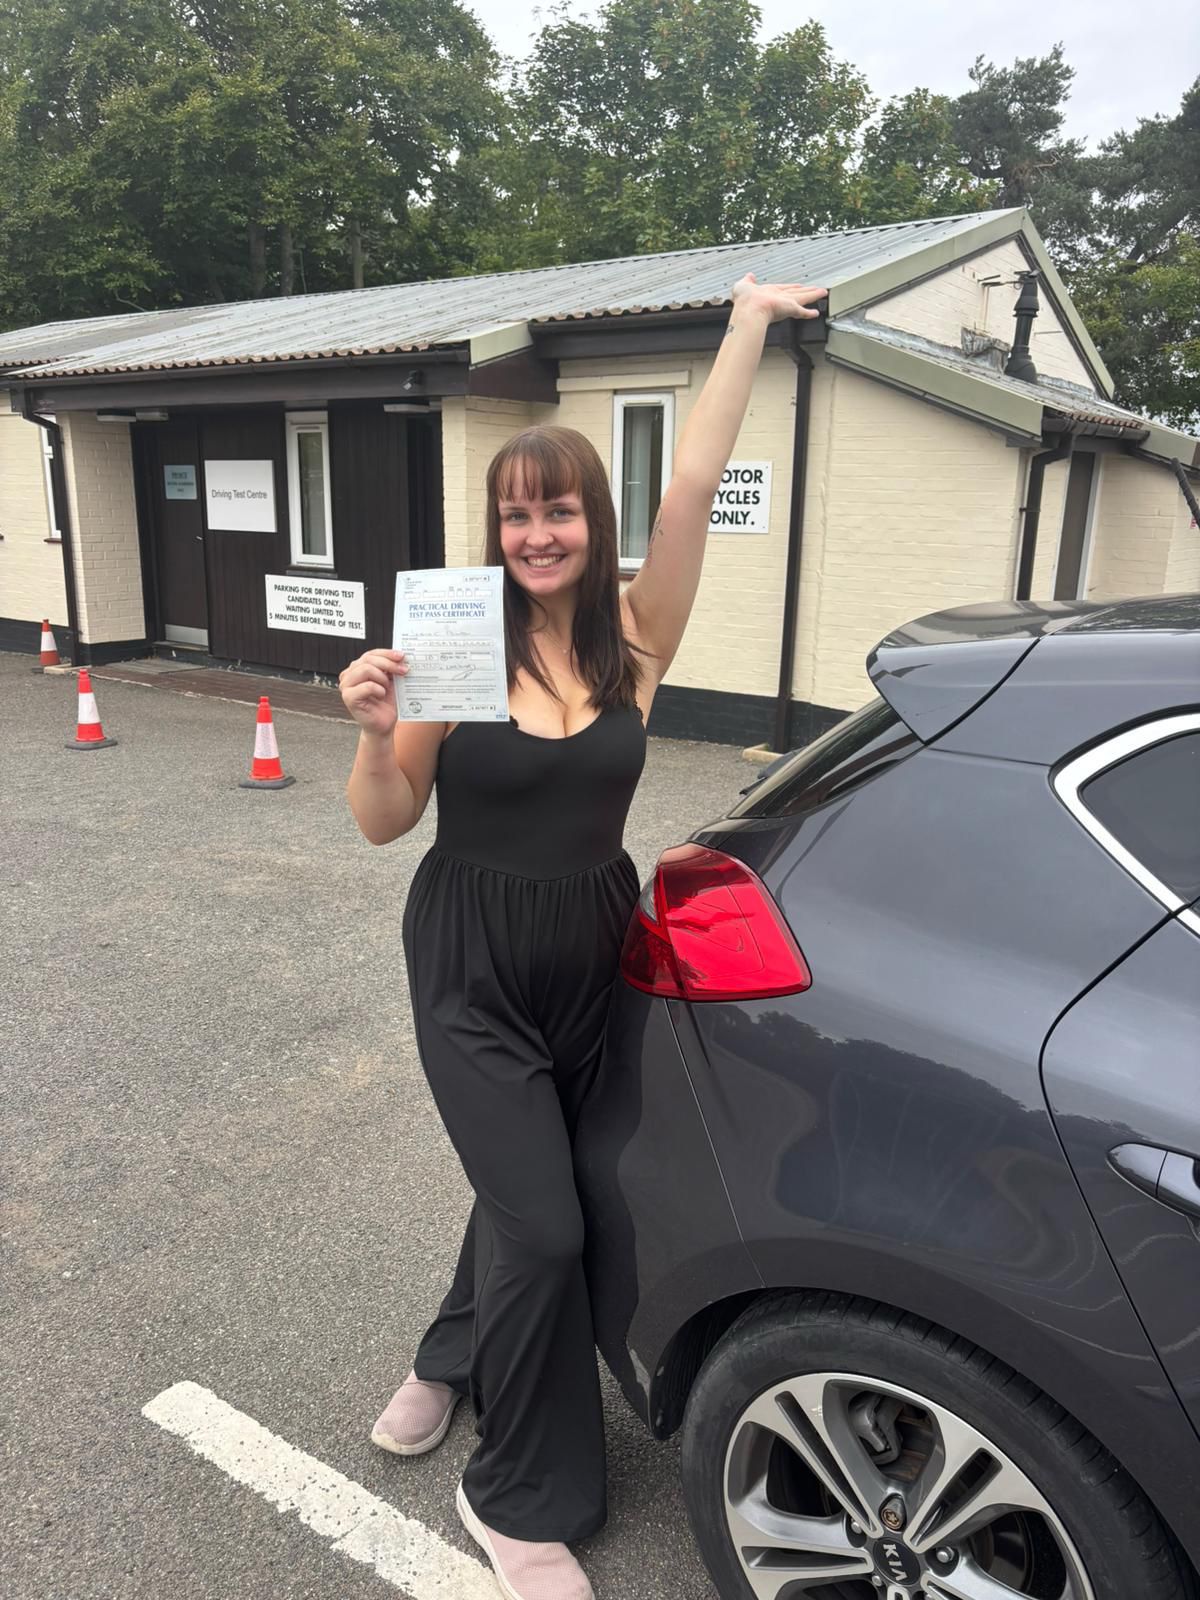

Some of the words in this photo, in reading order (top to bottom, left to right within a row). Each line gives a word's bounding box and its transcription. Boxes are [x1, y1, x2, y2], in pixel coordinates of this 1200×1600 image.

[721, 469, 763, 483] OTOR
[211, 489, 231, 500] Driving
[231, 489, 245, 498] Test
[247, 490, 268, 499] Centre
[713, 490, 760, 505] YCLES
[710, 510, 755, 526] ONLY.
[274, 584, 300, 594] PARKING
[301, 586, 312, 594] FOR
[315, 588, 339, 597] DRIVING
[341, 590, 354, 599] TEST
[287, 595, 322, 605] CANDIDATES
[323, 599, 341, 608] ONLY.
[409, 602, 448, 611] PRACTICAL
[450, 601, 486, 610] DRIVING
[285, 605, 310, 614] WAITING
[312, 607, 334, 616] LIMITED
[336, 610, 344, 618] TO
[409, 611, 424, 619] TEST
[424, 610, 441, 618] PASS
[442, 609, 486, 618] CERTIFICATE
[274, 613, 298, 623] MINUTES
[300, 615, 321, 625] BEFORE
[322, 618, 336, 627] TIME
[338, 620, 346, 628] OF
[347, 621, 363, 630] TEST.
[883, 1544, 908, 1581] KIA
